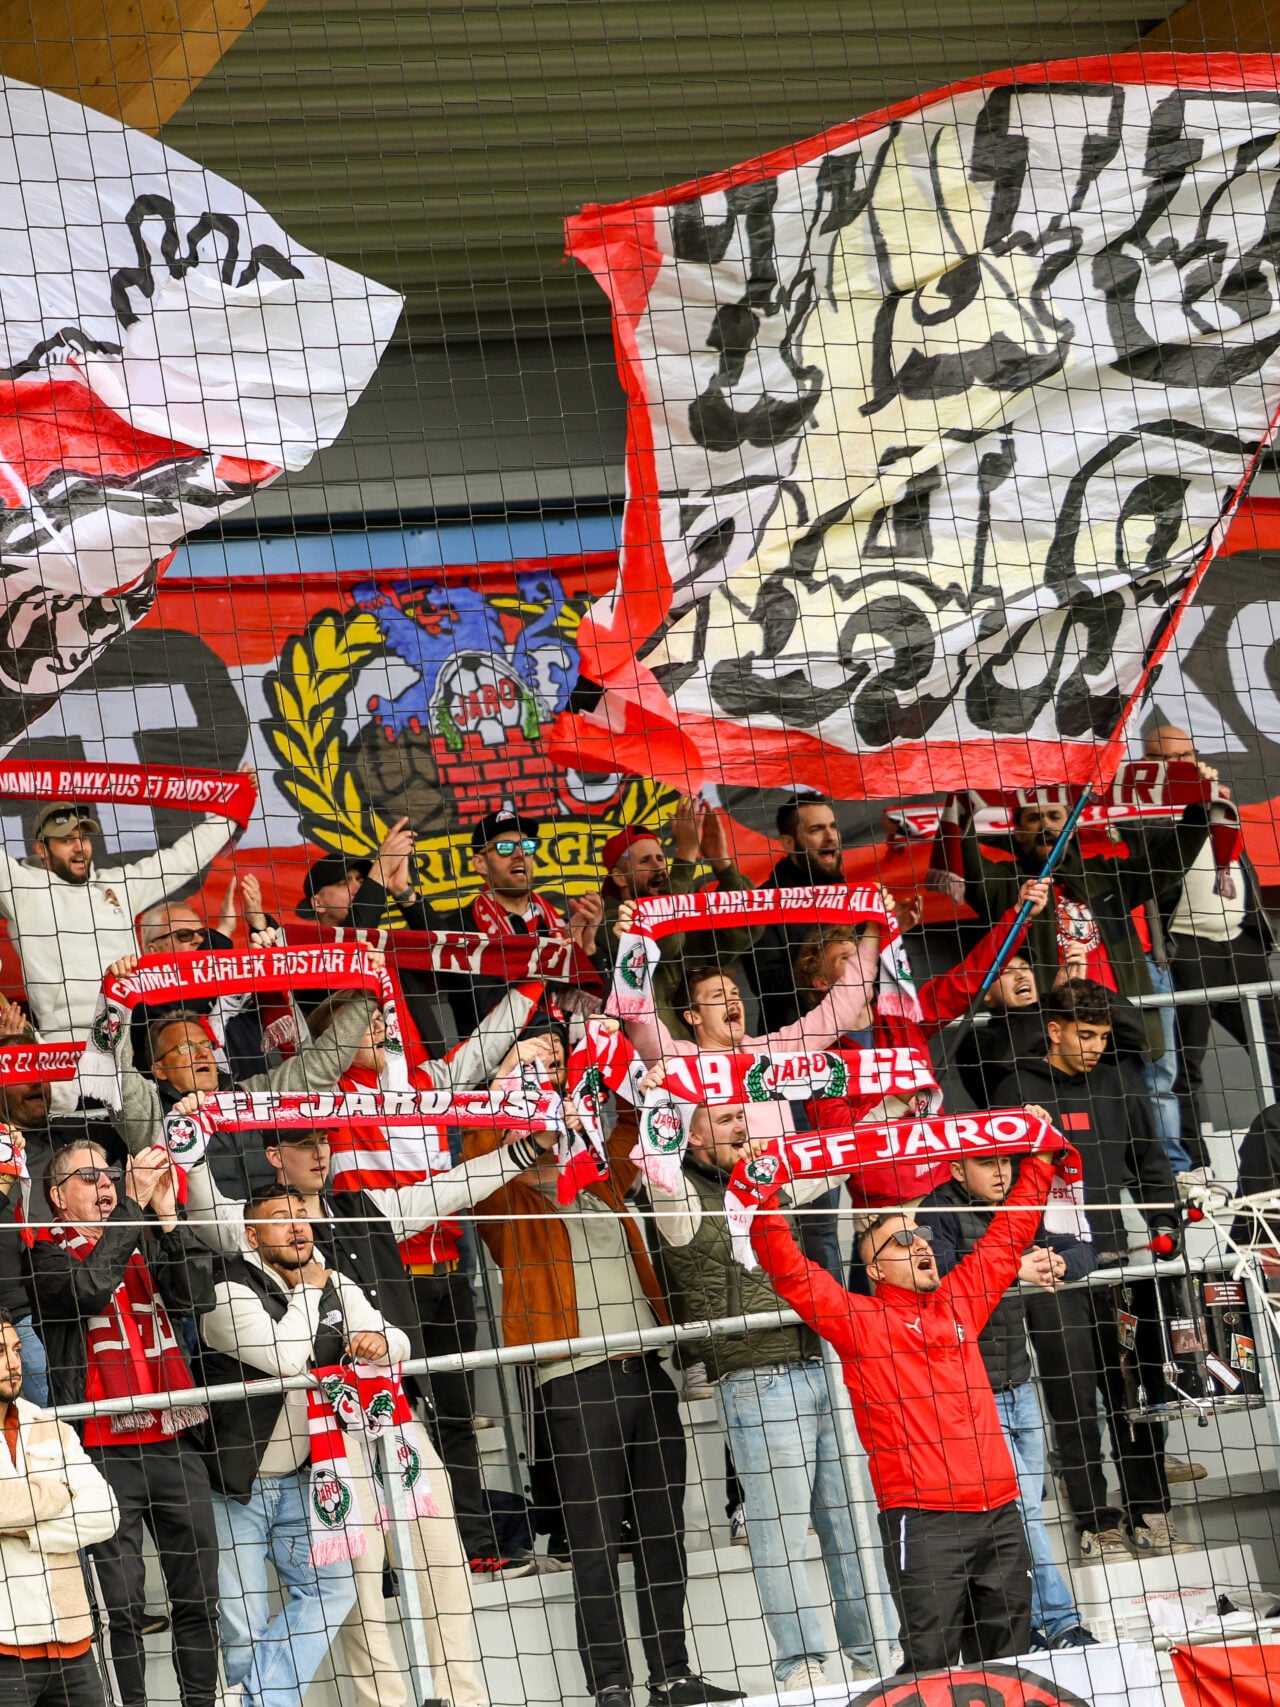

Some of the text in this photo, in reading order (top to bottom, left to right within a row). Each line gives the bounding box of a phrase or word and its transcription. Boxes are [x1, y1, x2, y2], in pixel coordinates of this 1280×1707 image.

[454, 678, 516, 725] JARO
[58, 772, 141, 797] RAKKAUS
[143, 776, 162, 799] EI
[164, 780, 239, 803] RUOSTU
[780, 886, 849, 910] ROSTAR
[191, 954, 265, 984] KÄRLEK
[272, 949, 344, 976] ROSTAR
[14, 1052, 32, 1073] EI
[666, 1047, 934, 1105] 19 JARO 65
[213, 1090, 543, 1121] FF JARO JS
[792, 1115, 1029, 1172] FF JARO
